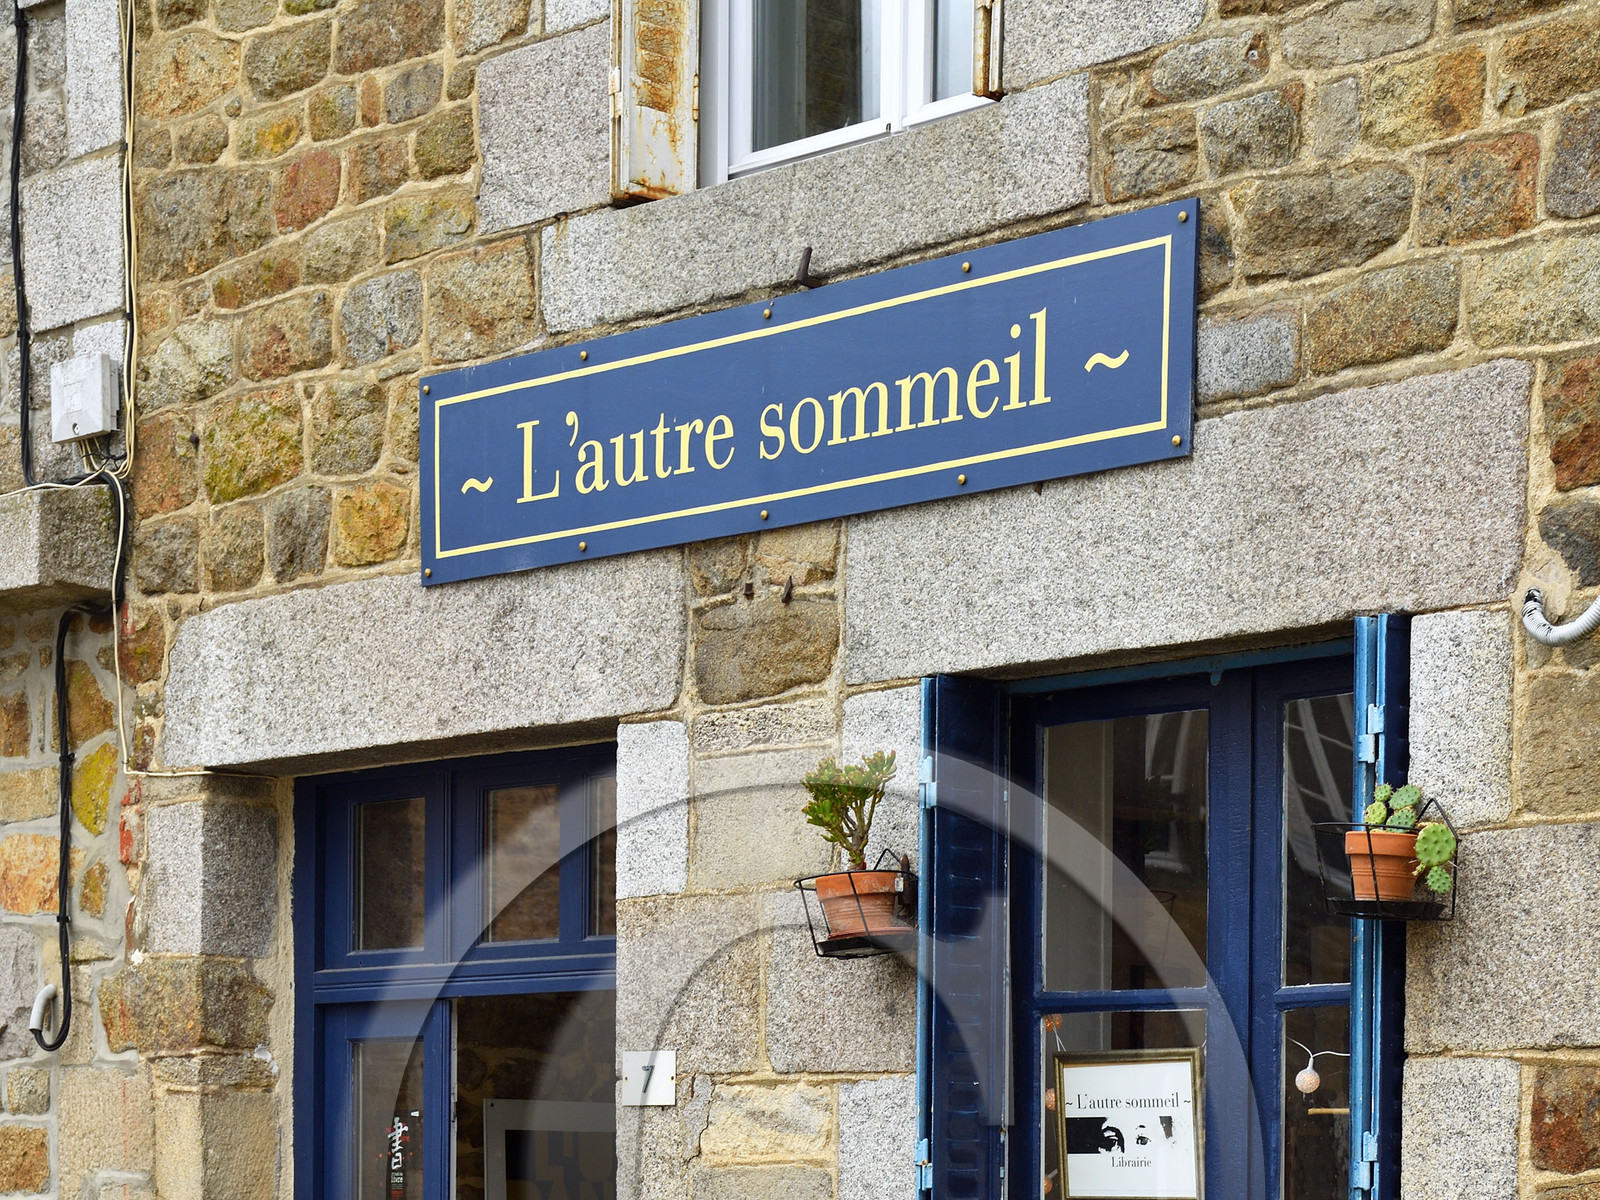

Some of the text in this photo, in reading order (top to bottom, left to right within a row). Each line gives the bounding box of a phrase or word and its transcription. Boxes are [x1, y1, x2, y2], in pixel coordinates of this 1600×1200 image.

[516, 306, 1052, 505] L'autre sommeil
[641, 1065, 655, 1093] 7
[1076, 1092, 1179, 1109] L'autre sommeil
[1111, 1156, 1152, 1168] Librairie
